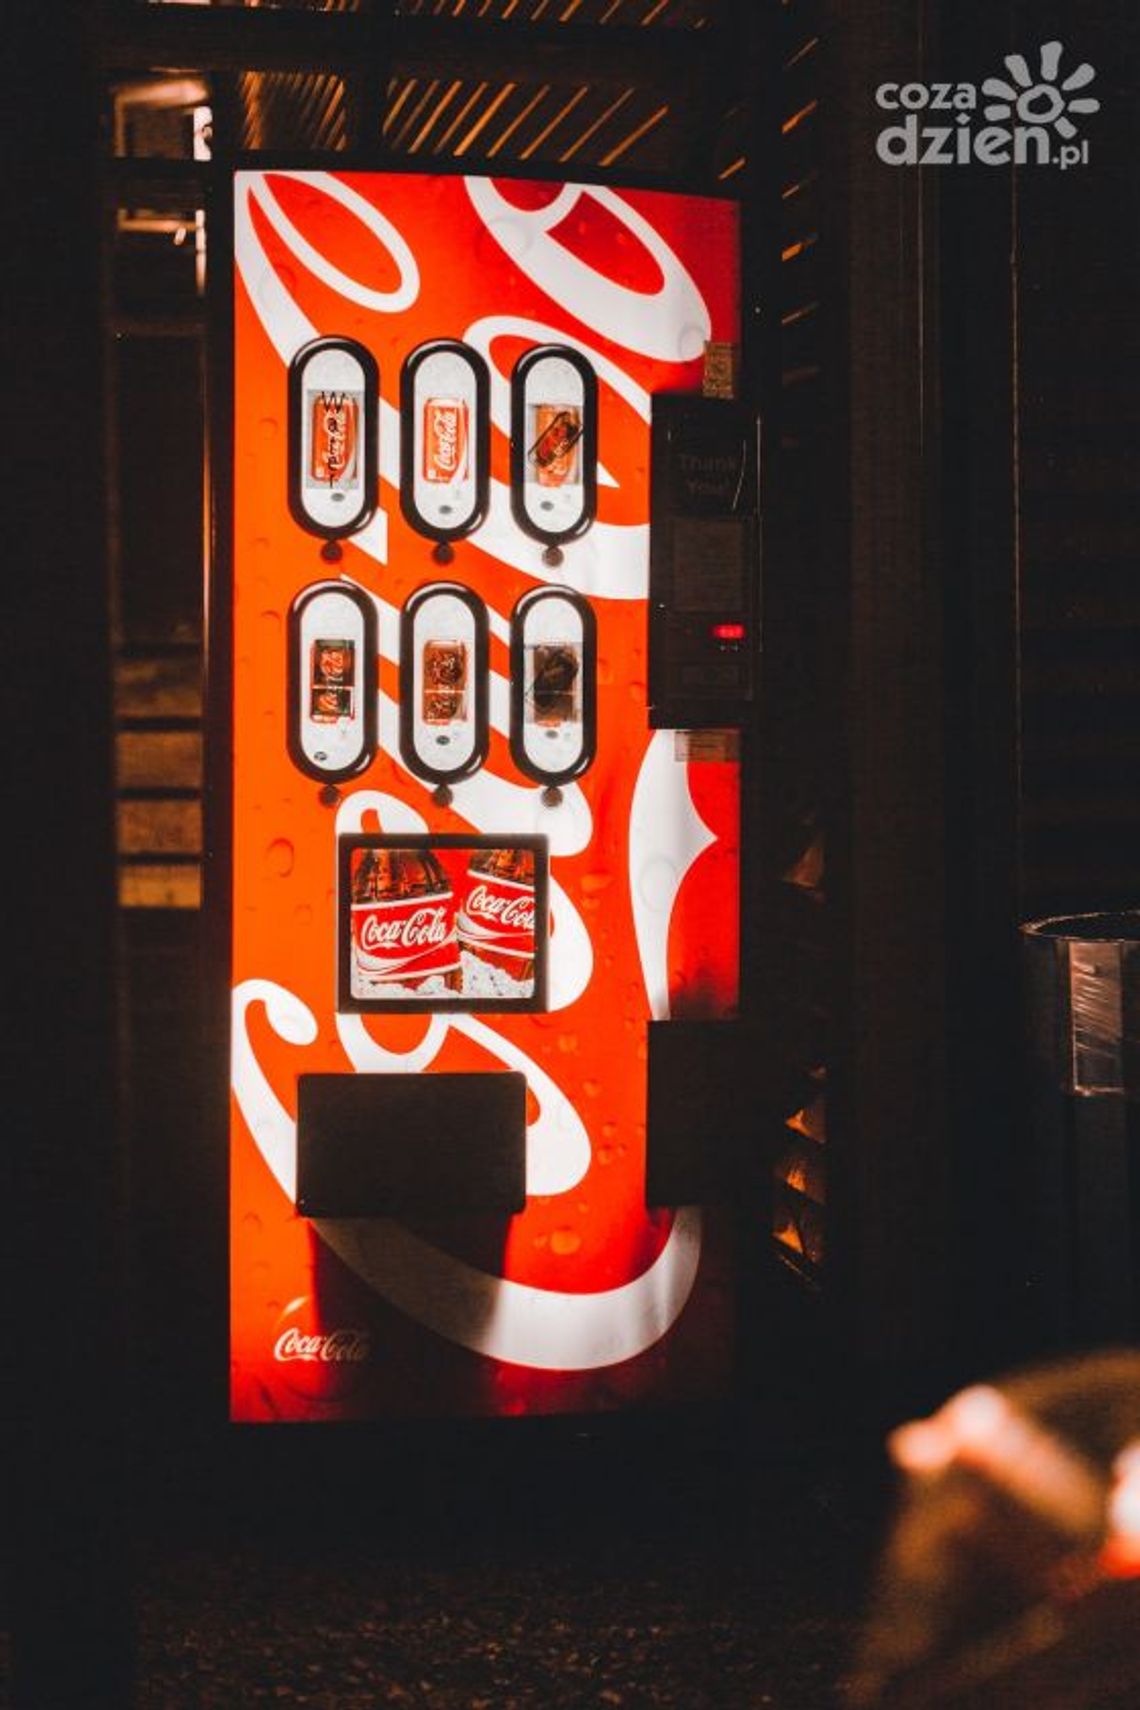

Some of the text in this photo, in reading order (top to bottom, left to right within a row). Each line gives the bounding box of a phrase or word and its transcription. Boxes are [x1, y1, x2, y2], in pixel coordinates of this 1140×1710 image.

[677, 453, 738, 471] Thank
[361, 907, 447, 950] Coca-Cola
[274, 1327, 370, 1361] Coca-Cola
